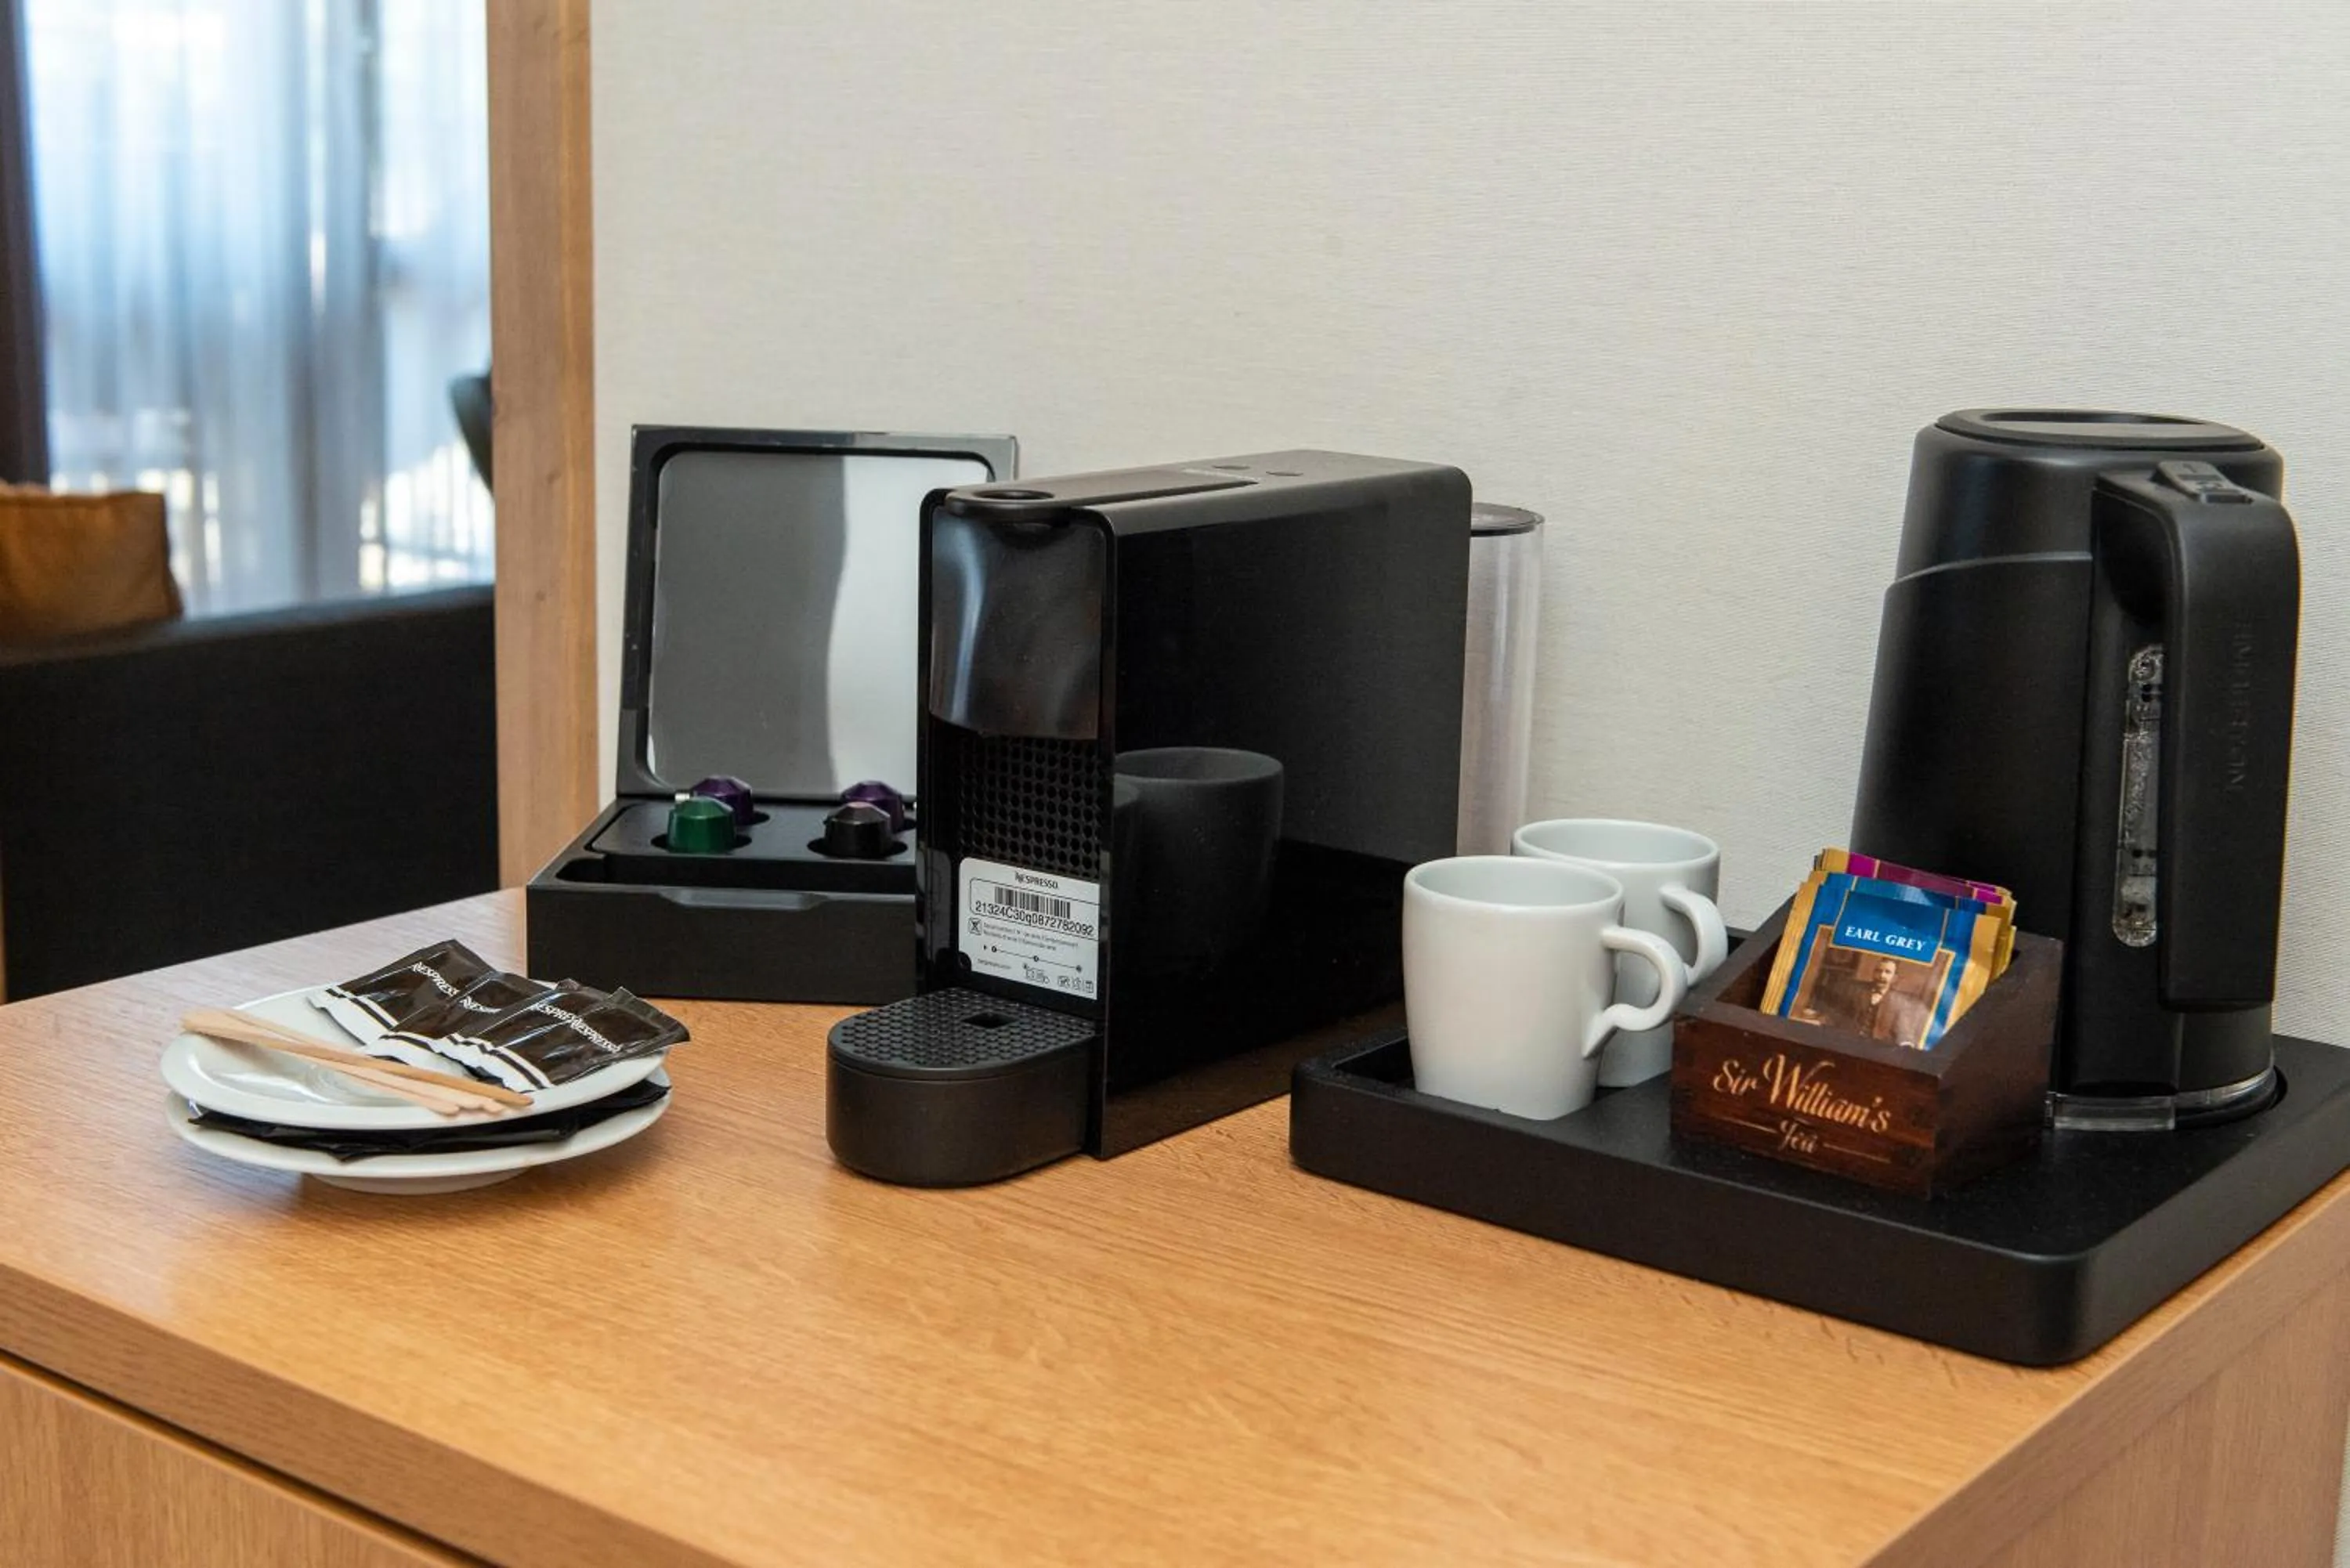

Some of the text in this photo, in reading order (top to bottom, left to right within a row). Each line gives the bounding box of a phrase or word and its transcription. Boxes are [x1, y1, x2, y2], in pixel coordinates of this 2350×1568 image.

[1015, 872, 1058, 889] NESPRESSO
[1845, 926, 1926, 951] EARL GREY
[1712, 1053, 1891, 1133] Sir William's
[1778, 1117, 1819, 1154] Tea
